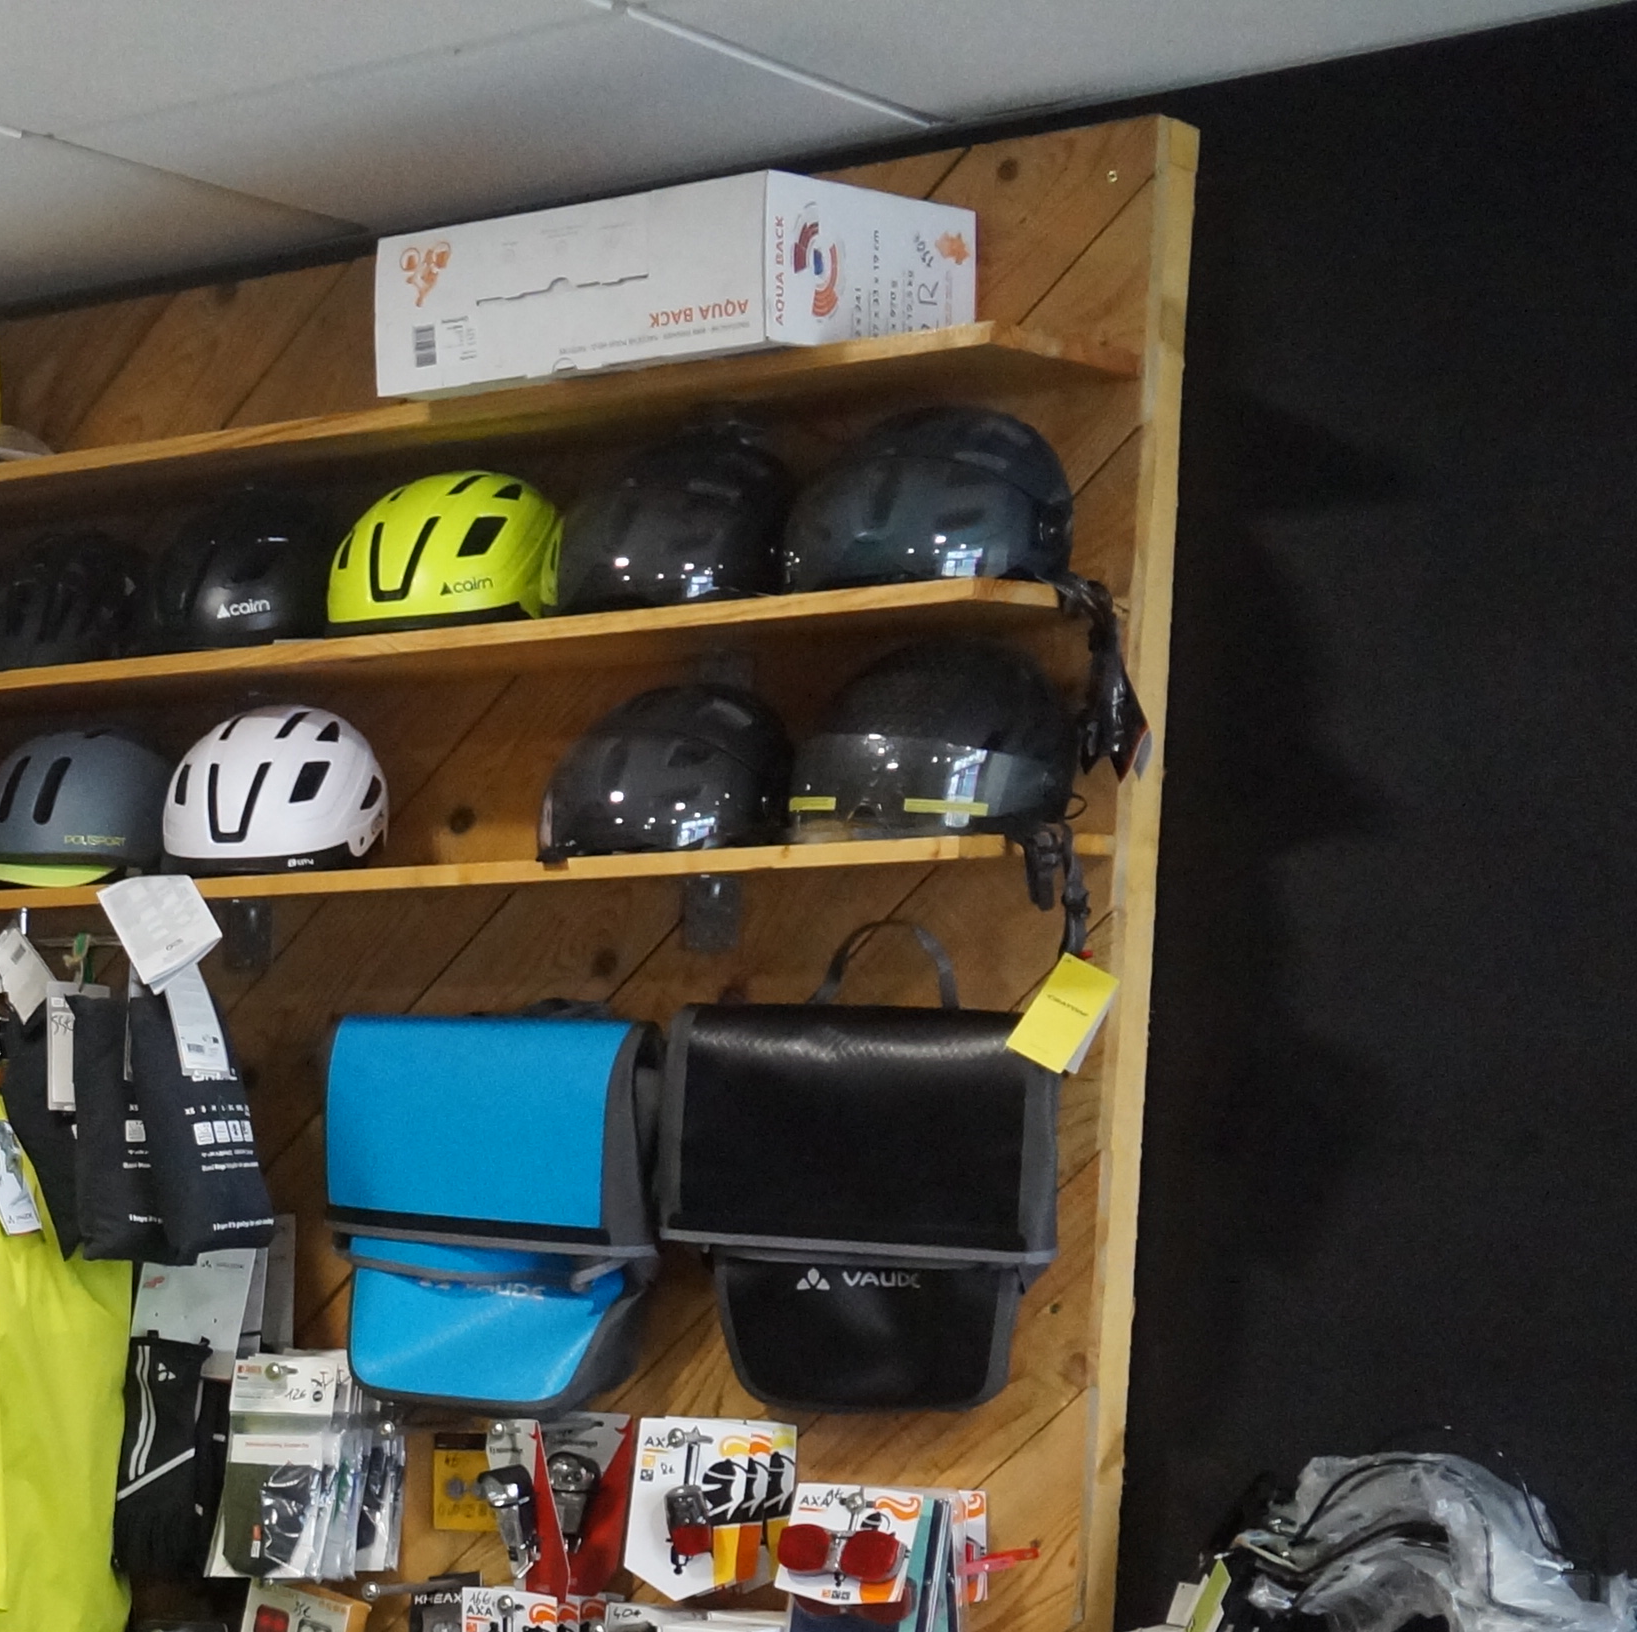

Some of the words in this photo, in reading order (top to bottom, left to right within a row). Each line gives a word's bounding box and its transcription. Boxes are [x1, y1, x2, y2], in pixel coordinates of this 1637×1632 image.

[775, 216, 785, 266] BACK
[702, 298, 750, 321] AQUA
[775, 271, 785, 326] AQUA
[648, 305, 693, 328] BACK
[452, 576, 494, 594] cairn
[230, 598, 271, 617] cairn
[466, 1604, 493, 1617] AXA
